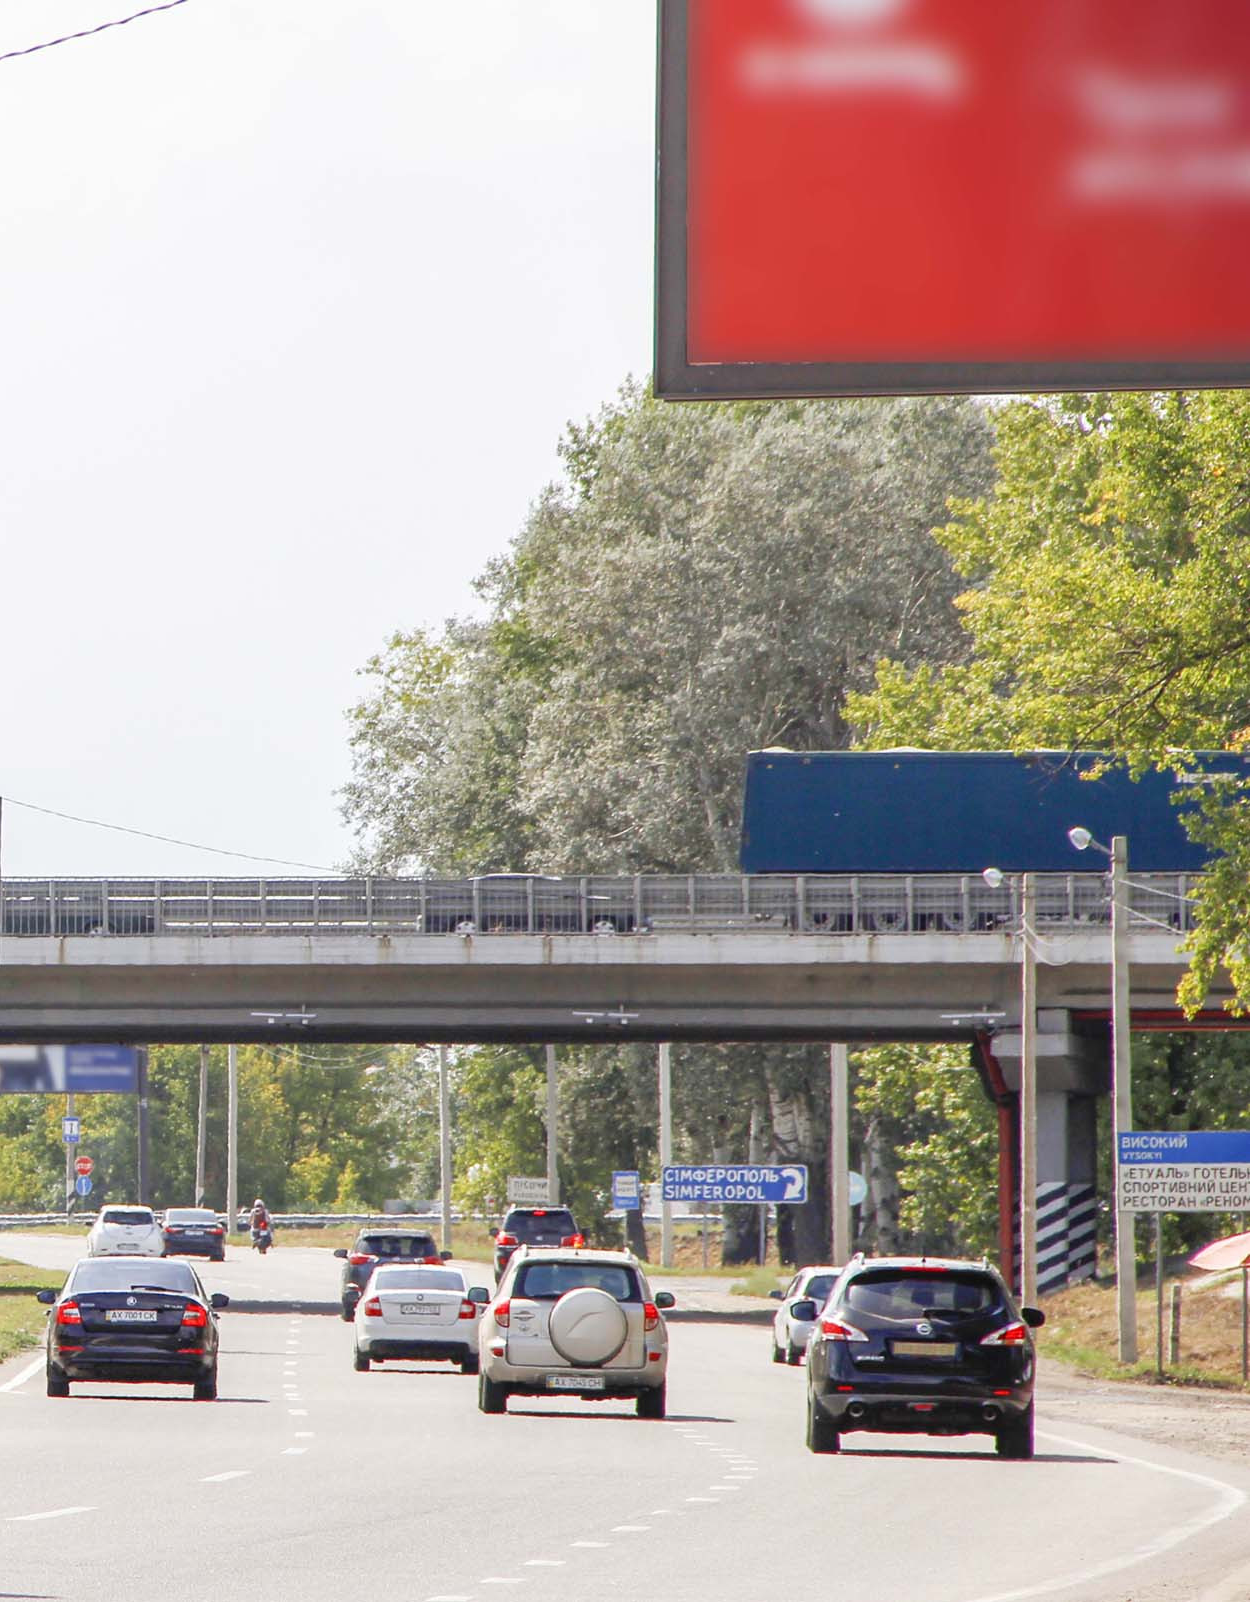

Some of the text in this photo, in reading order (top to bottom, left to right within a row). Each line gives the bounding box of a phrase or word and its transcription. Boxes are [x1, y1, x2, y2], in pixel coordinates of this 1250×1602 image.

[1122, 1135, 1188, 1149] ВИСОКИЙ
[664, 1169, 779, 1183] СІМФЕРОПОЛЬ
[1124, 1168, 1190, 1179] «ЕТУАЛЬ»
[664, 1185, 765, 1199] SIMFEROPOL
[1123, 1181, 1215, 1193] СПОРТИВНИЙ
[1124, 1196, 1196, 1207] РЕСТОРАН
